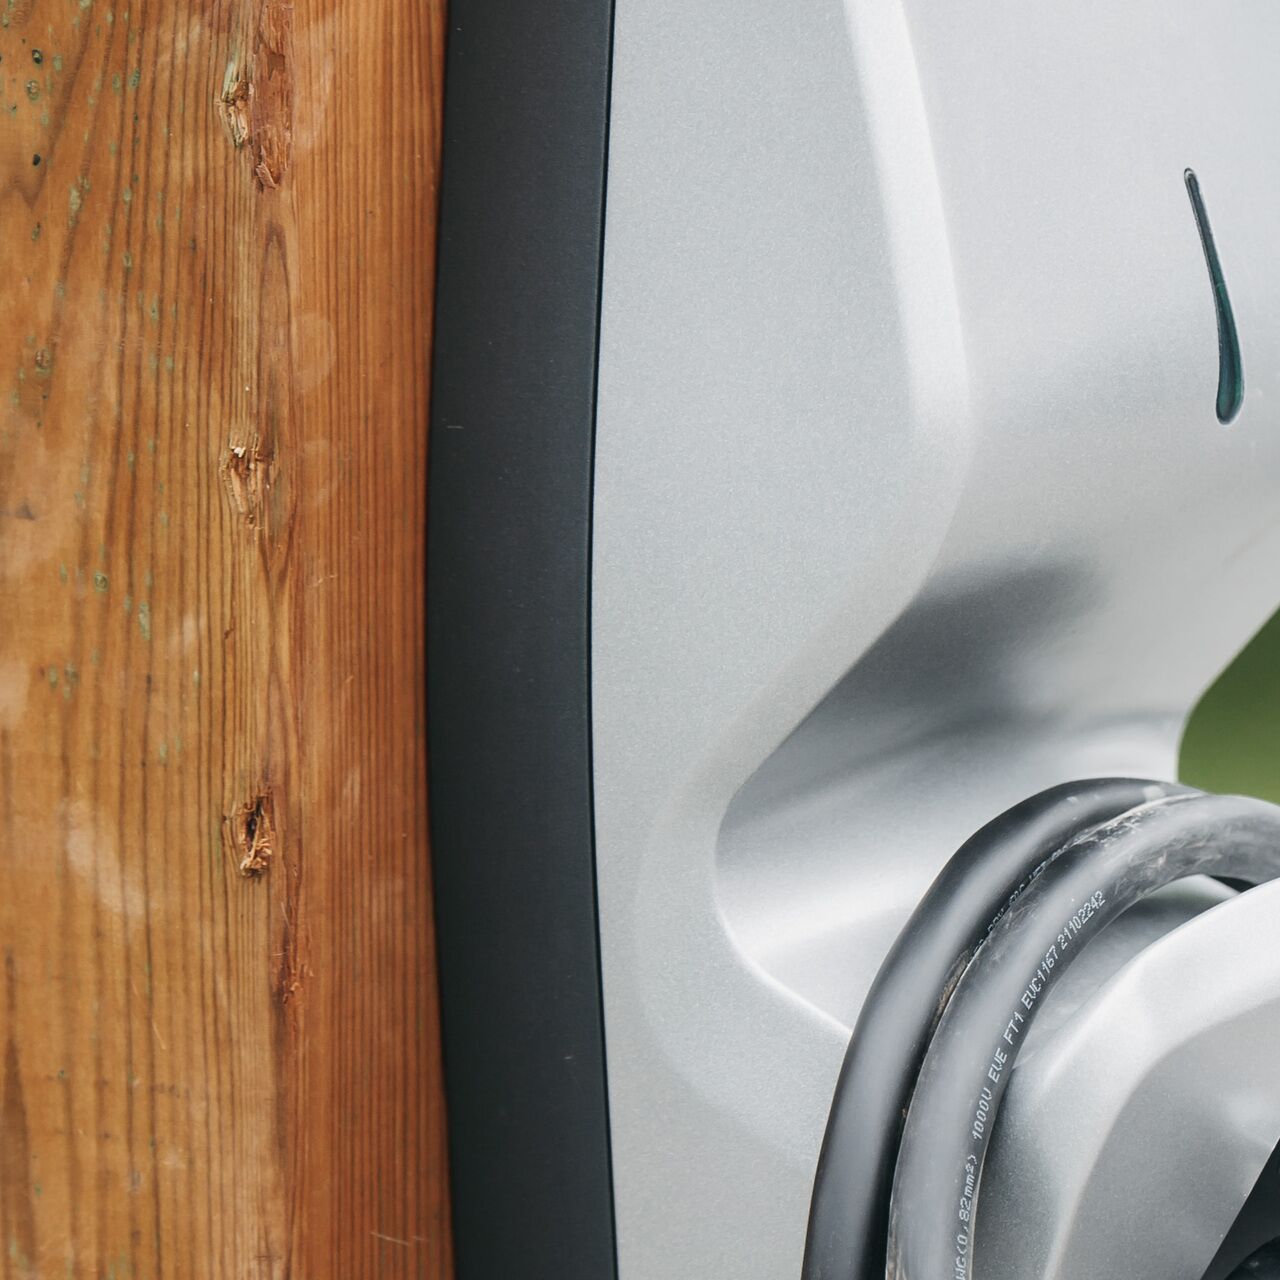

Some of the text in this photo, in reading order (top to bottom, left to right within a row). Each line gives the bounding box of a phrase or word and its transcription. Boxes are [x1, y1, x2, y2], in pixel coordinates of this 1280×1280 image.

[971, 1086, 993, 1140] 1000V
[987, 1046, 1009, 1083] EVE
[1003, 1010, 1024, 1045] FT1
[1020, 944, 1059, 1010] EVC1167
[1056, 889, 1107, 950] 21102242
